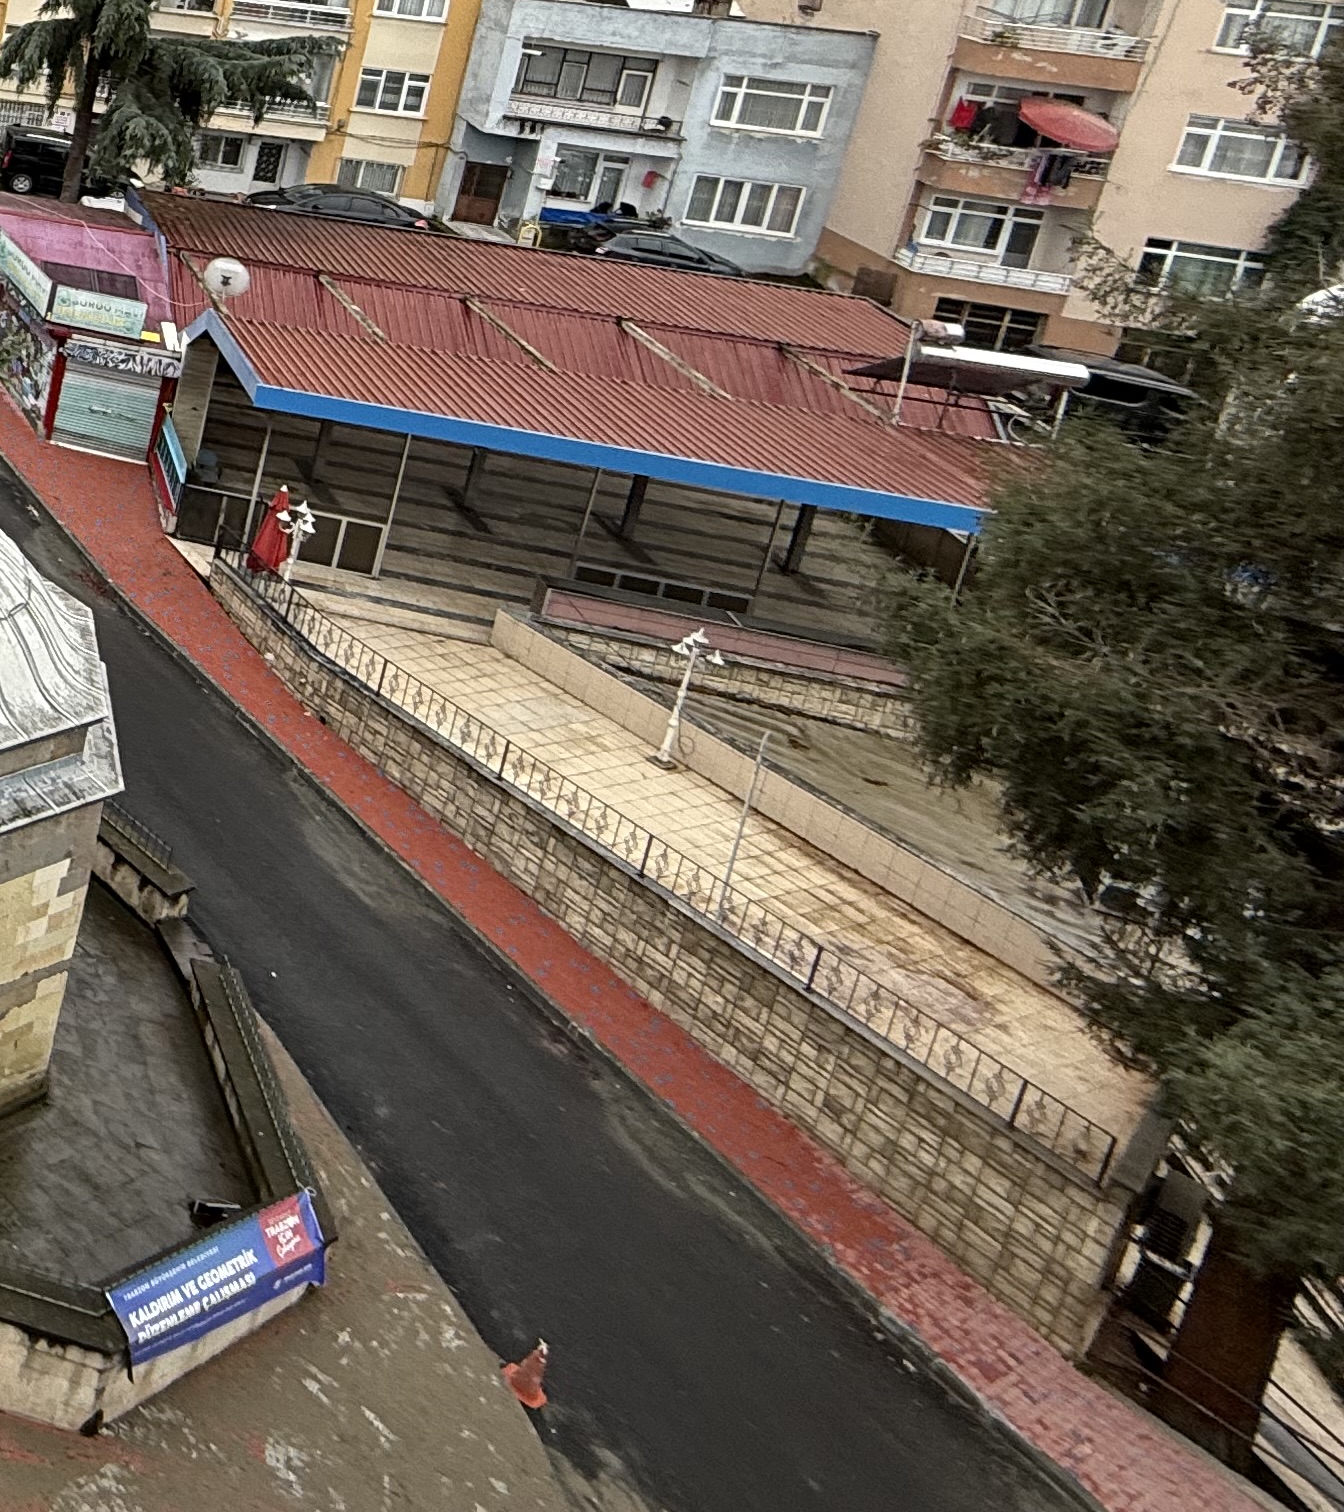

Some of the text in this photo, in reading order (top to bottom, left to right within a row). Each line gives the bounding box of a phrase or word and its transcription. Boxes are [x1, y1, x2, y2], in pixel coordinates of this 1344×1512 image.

[129, 1288, 184, 1328] KALDIRIM
[180, 1280, 199, 1299] VE
[197, 1248, 258, 1290] GEOMETRİK
